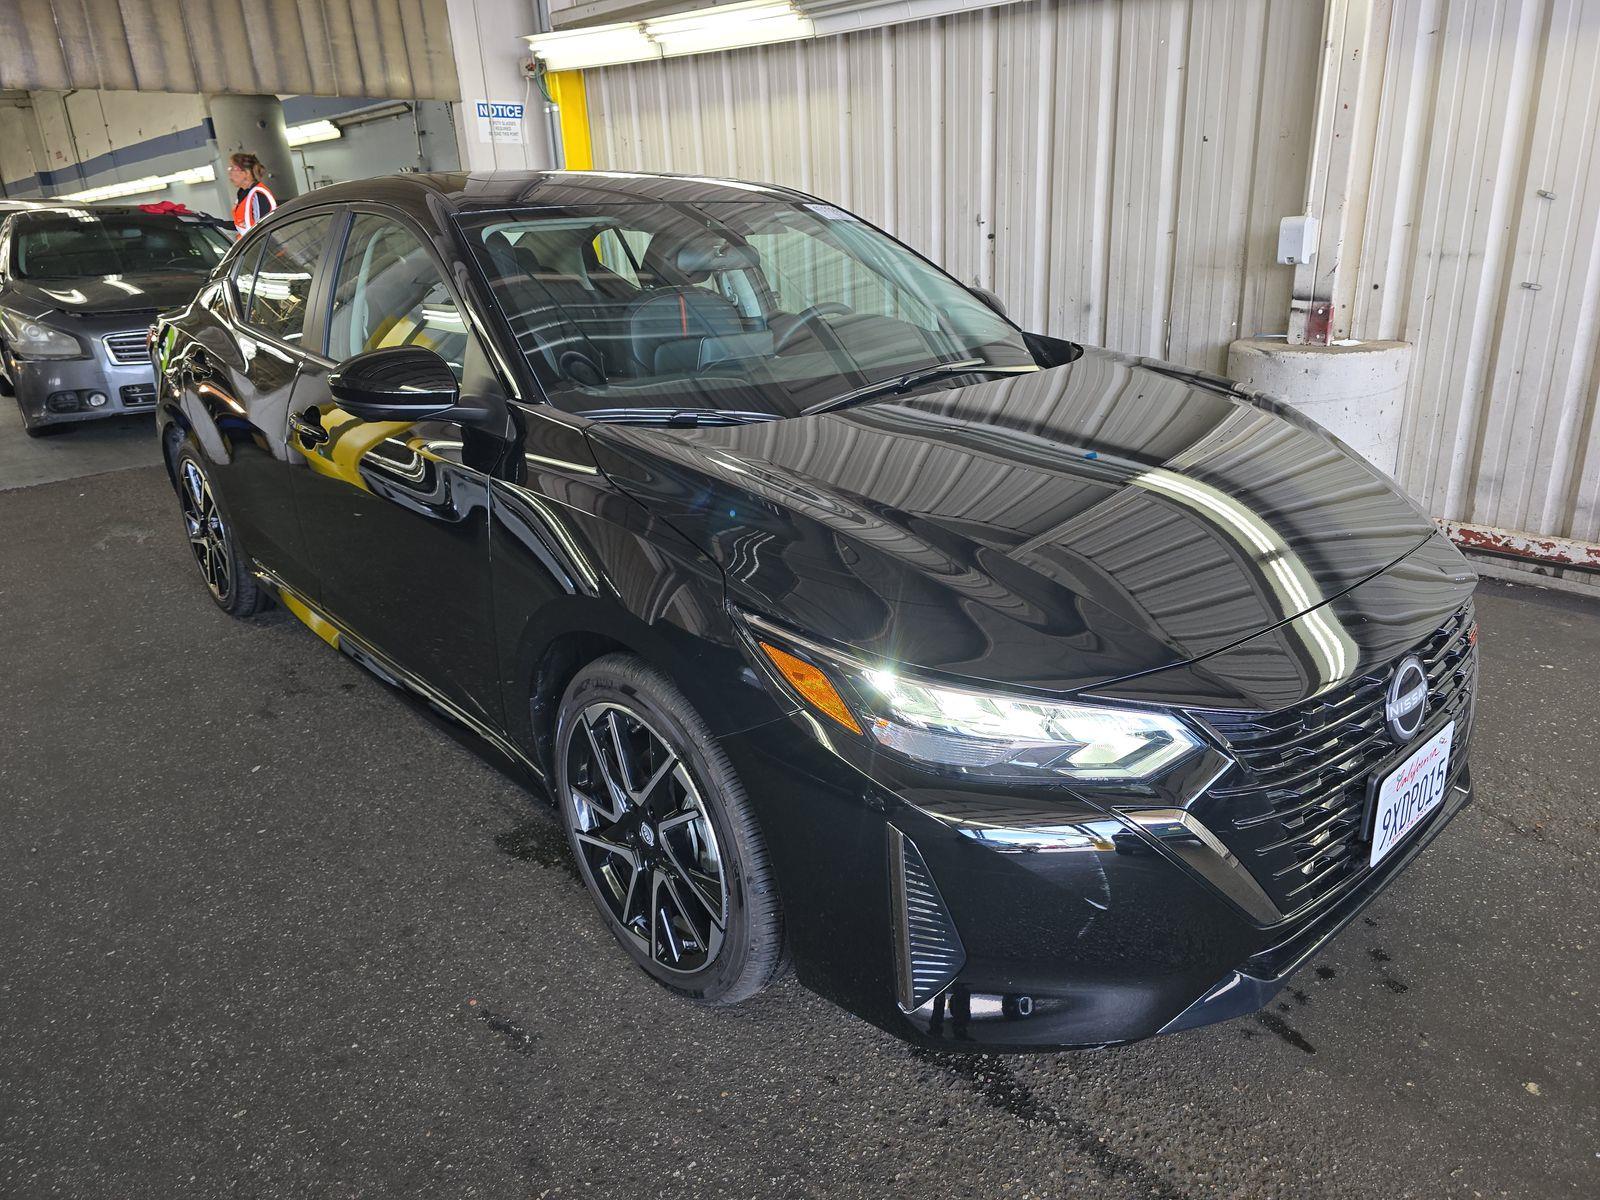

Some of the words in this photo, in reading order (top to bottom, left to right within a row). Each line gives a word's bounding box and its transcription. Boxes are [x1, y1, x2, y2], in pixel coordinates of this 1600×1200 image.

[479, 105, 522, 117] NOTICE
[1389, 683, 1427, 719] NISSAN
[1395, 748, 1440, 792] California
[1379, 757, 1446, 851] 9XDP015
